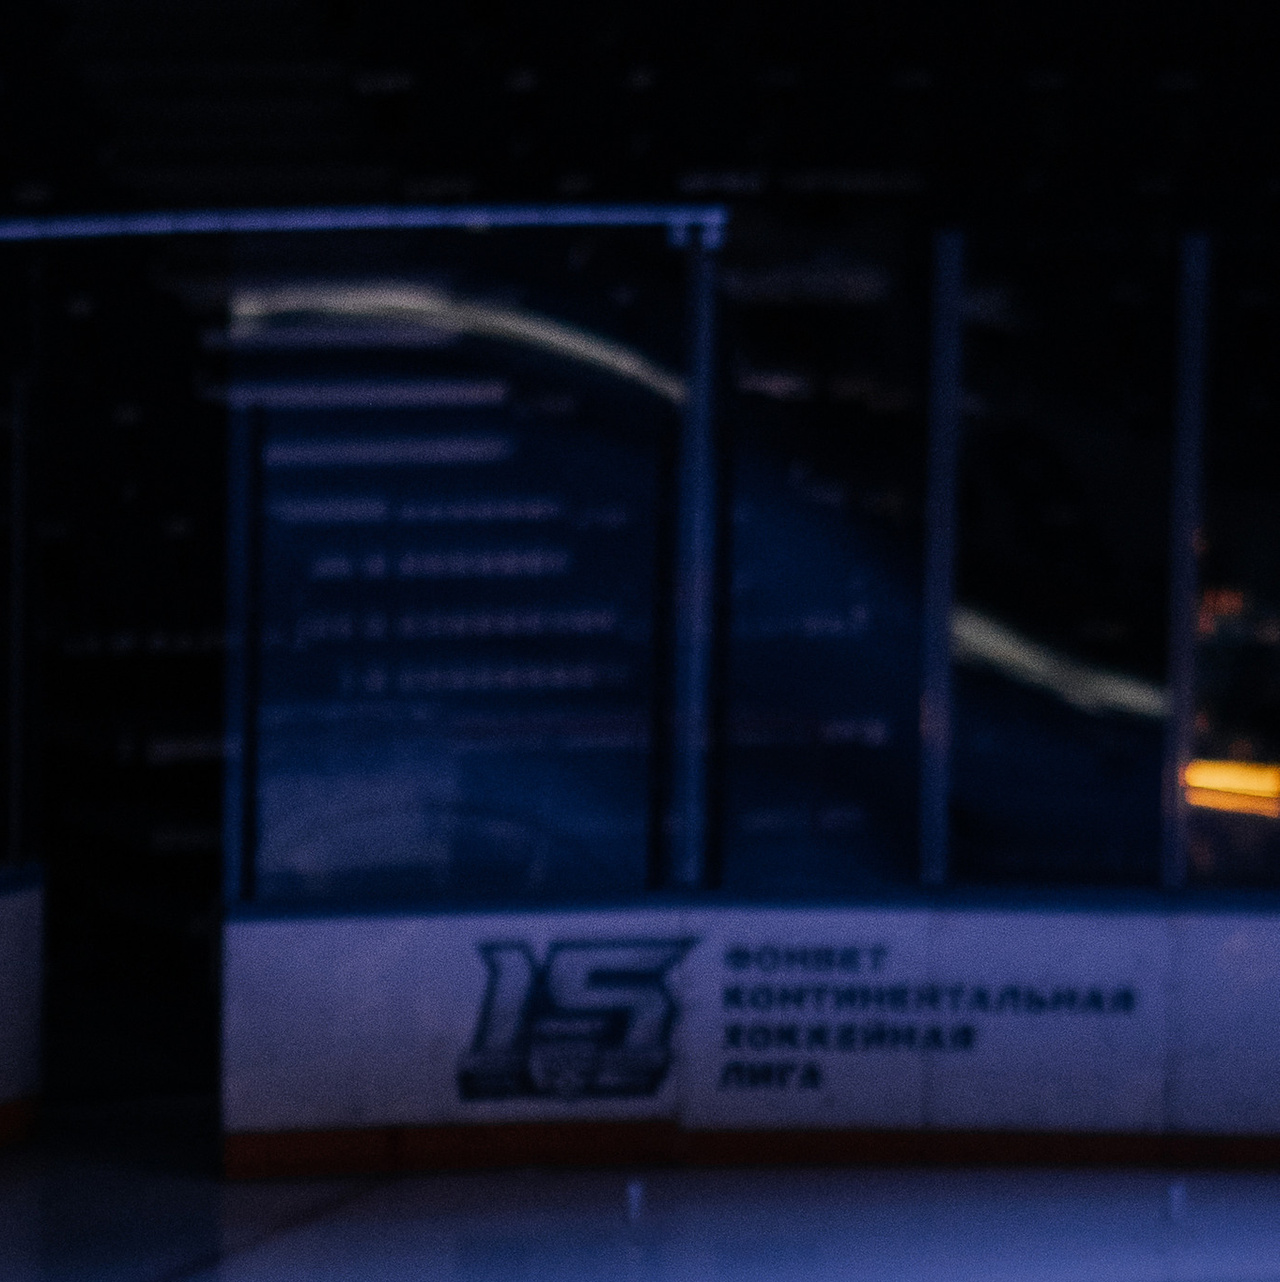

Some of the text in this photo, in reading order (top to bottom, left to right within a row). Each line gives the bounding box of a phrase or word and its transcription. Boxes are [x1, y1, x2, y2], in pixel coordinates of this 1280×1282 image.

[723, 984, 1136, 1014] КОНТИНЕНТАЛЬНАЯ
[723, 1023, 975, 1050] ХОККЕЙНАЯ
[721, 1060, 822, 1089] ЛИГА
